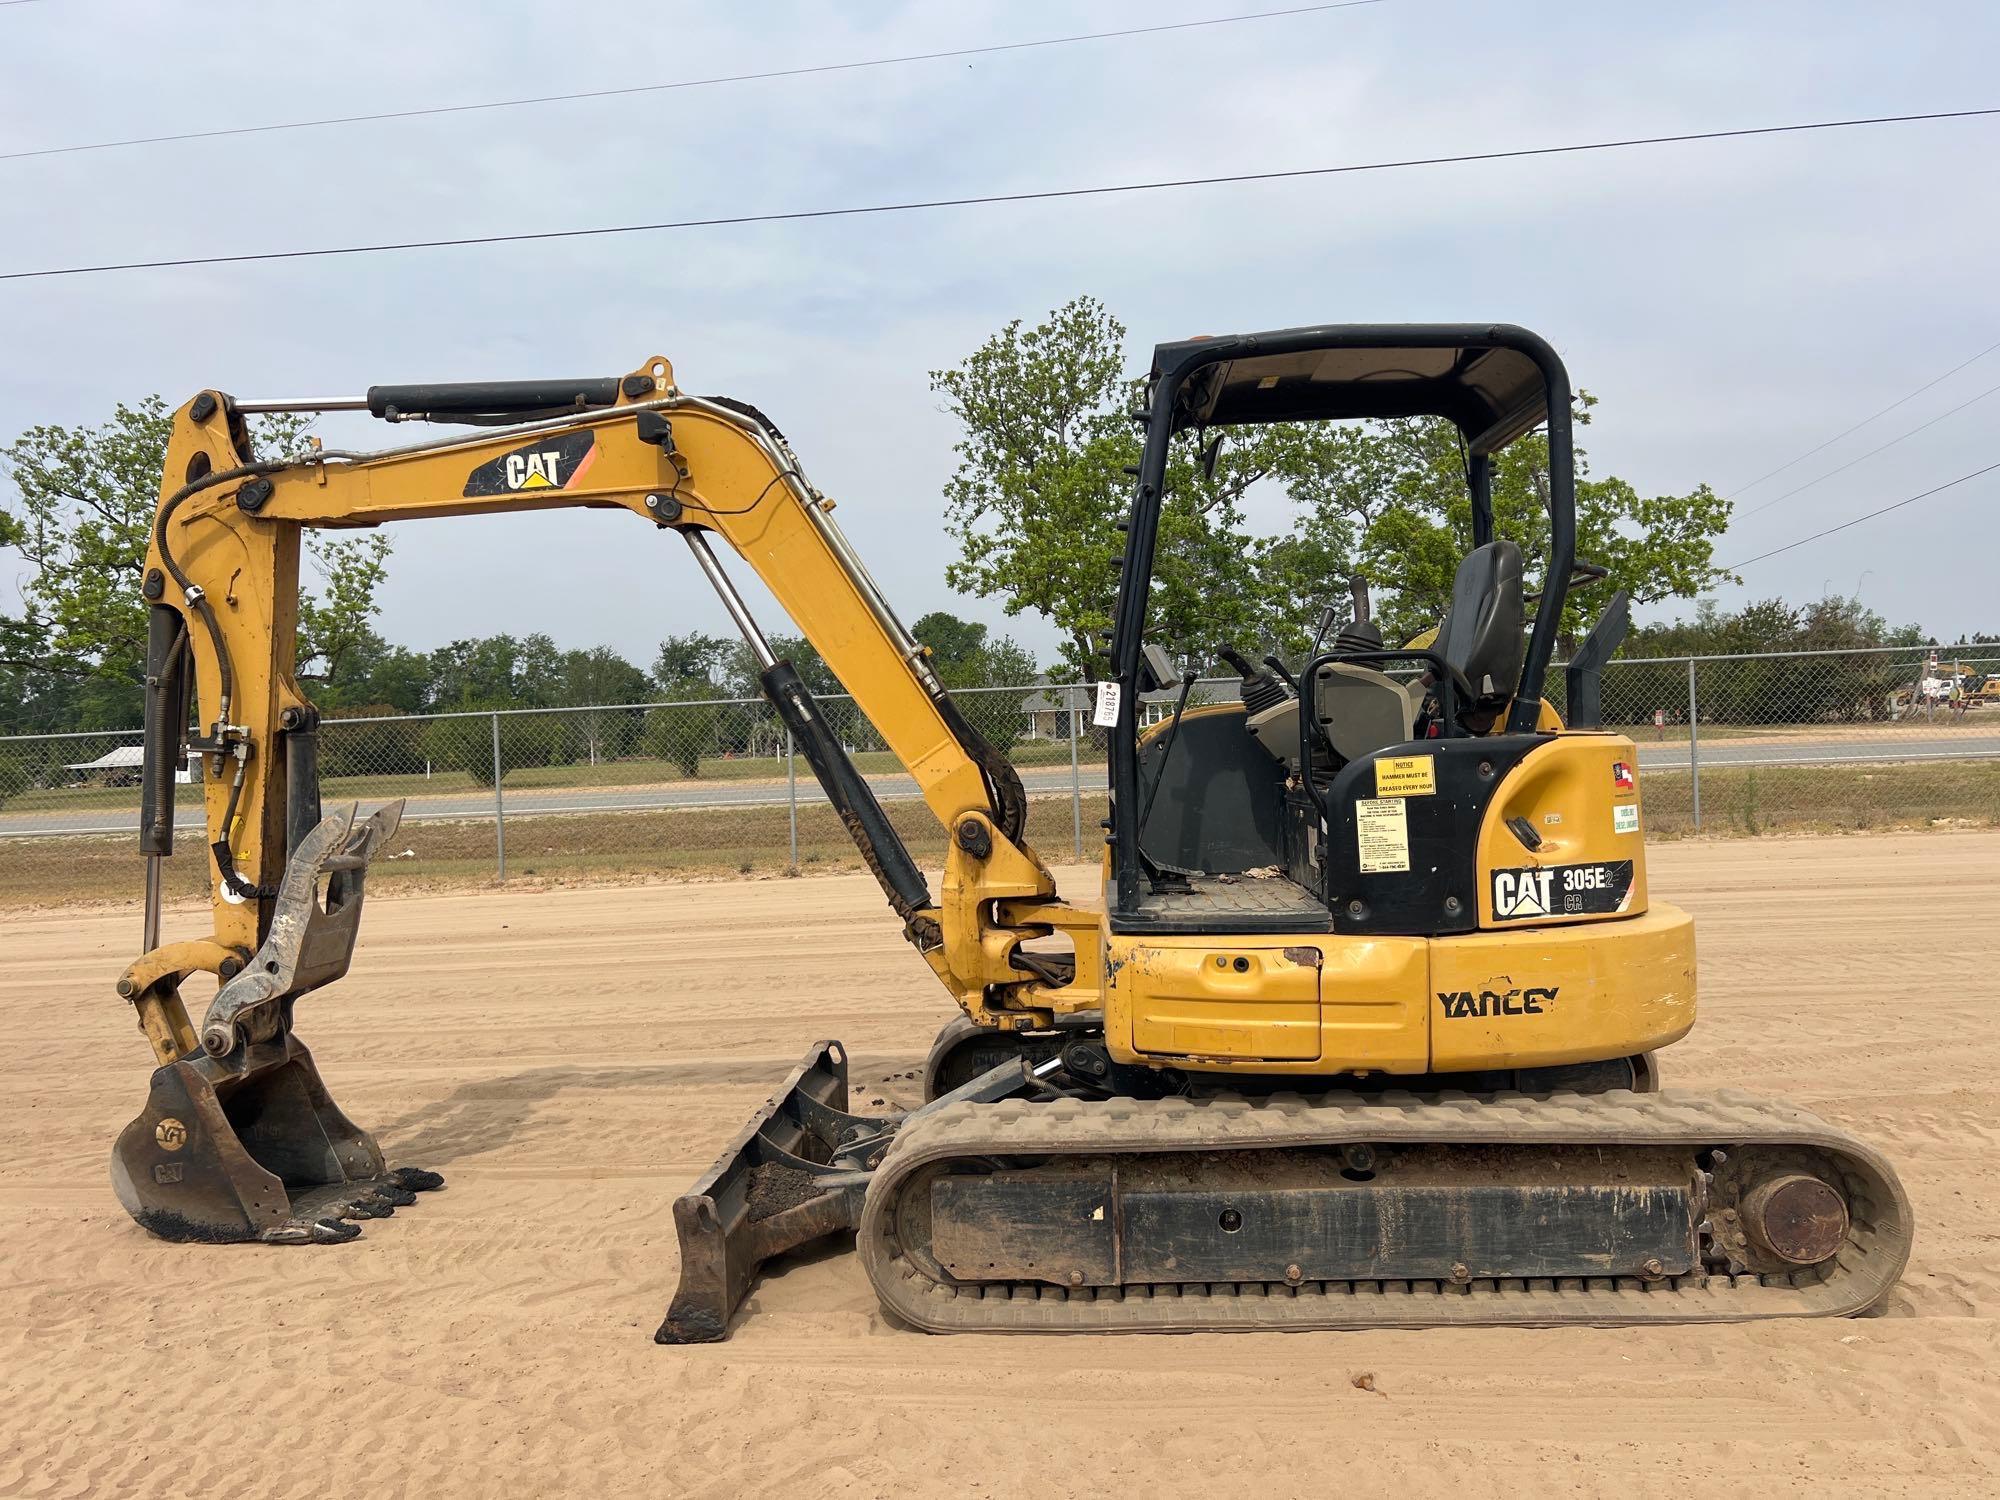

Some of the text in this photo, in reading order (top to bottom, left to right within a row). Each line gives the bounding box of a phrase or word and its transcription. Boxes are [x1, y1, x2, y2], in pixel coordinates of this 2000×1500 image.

[506, 451, 561, 489] CAT
[1395, 761, 1414, 769] NOTICE
[1495, 870, 1554, 916] CAT
[1564, 894, 1583, 911] CR
[1436, 986, 1560, 1018] YANCEY
